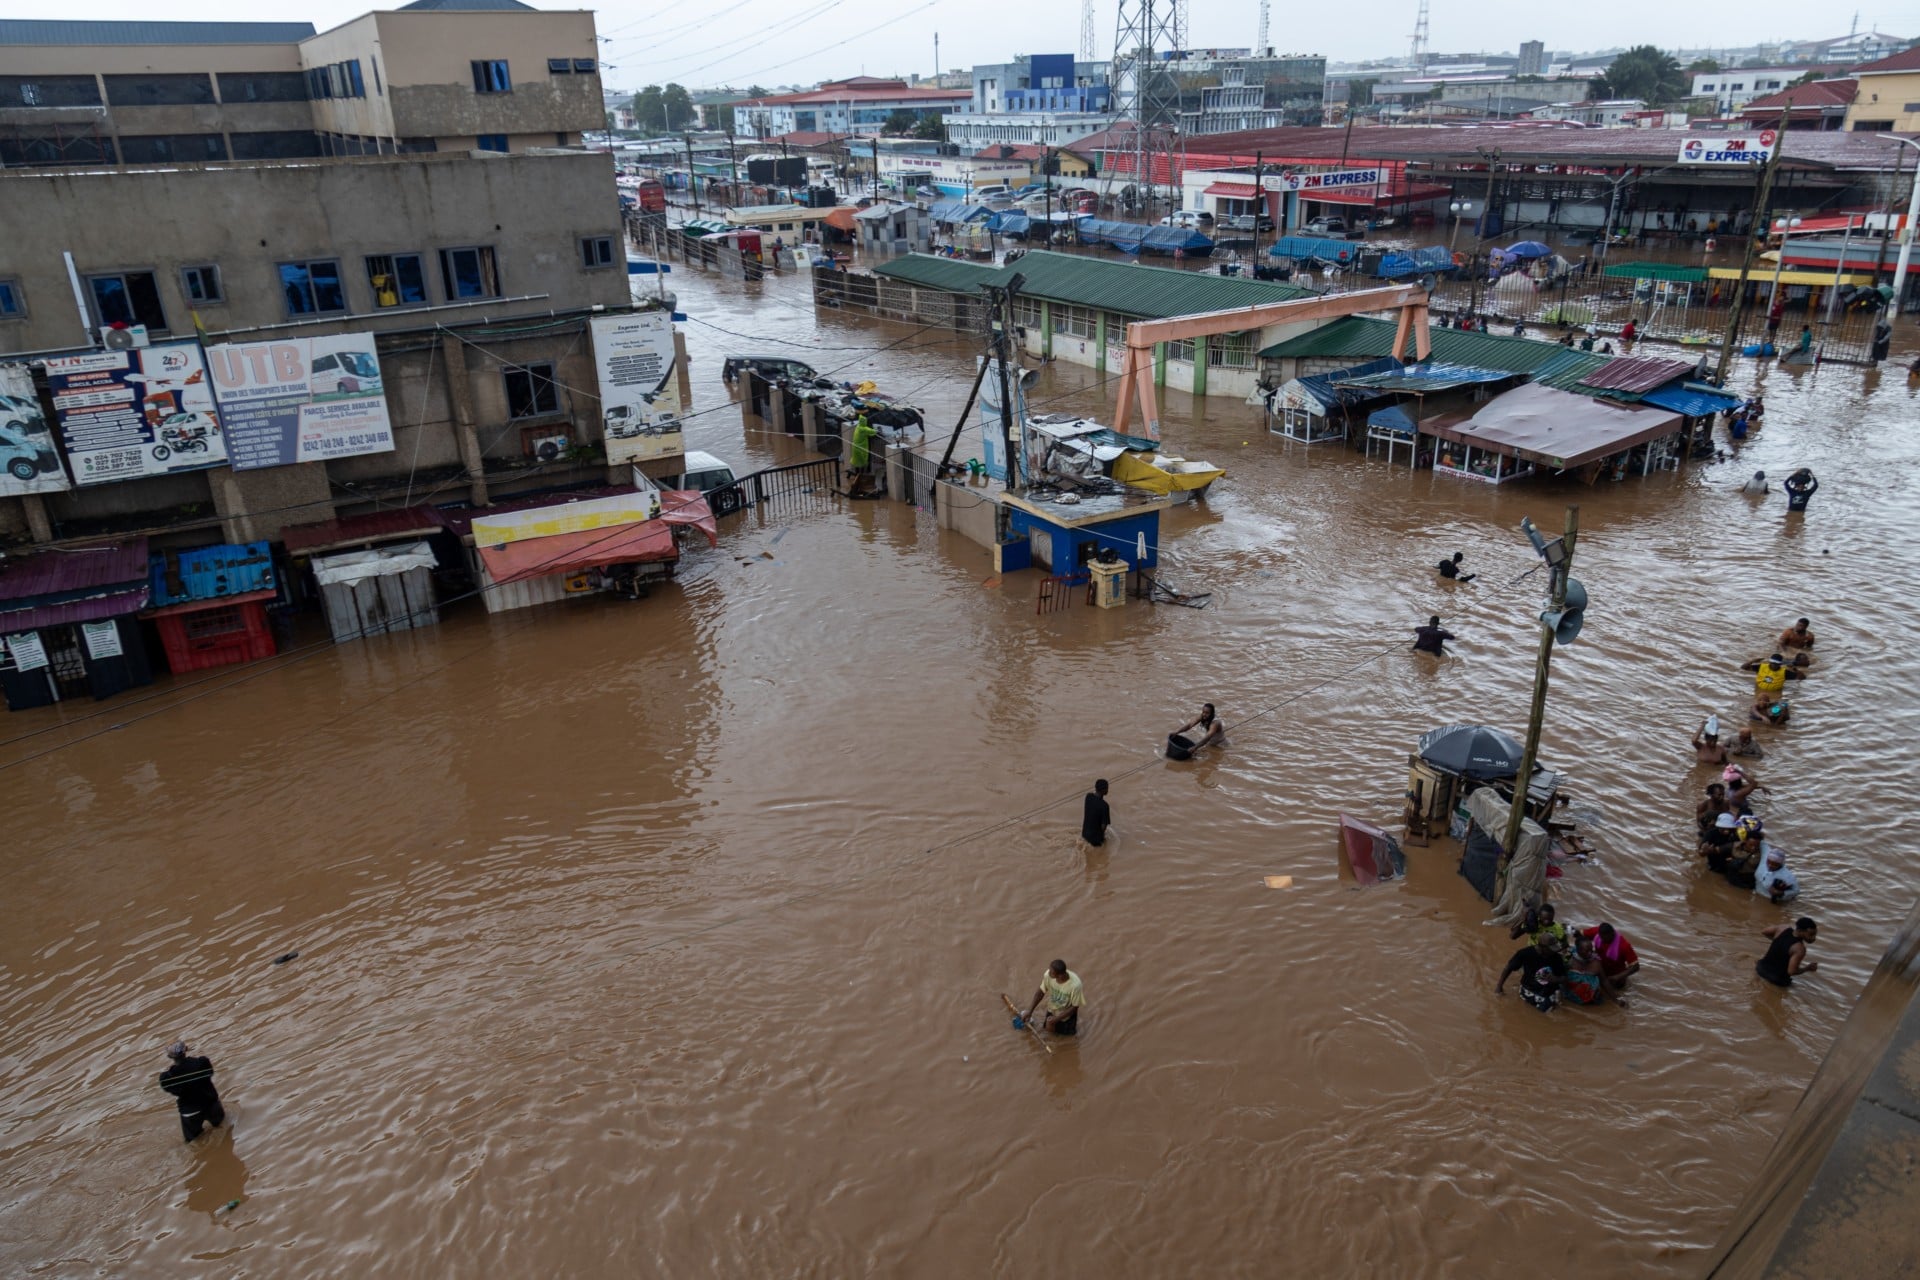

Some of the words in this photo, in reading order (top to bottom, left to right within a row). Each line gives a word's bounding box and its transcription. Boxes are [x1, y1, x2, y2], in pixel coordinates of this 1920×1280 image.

[1726, 140, 1746, 150] 2M
[1705, 151, 1768, 162] EXPRESS
[1304, 176, 1321, 188] 2M
[1323, 171, 1376, 186] EXPRESS
[209, 344, 304, 388] UTB
[250, 386, 280, 396] TRANSPORTS
[304, 406, 326, 415] PARCEL
[328, 404, 350, 412] SERVICE
[352, 400, 381, 410] AVAILABLE
